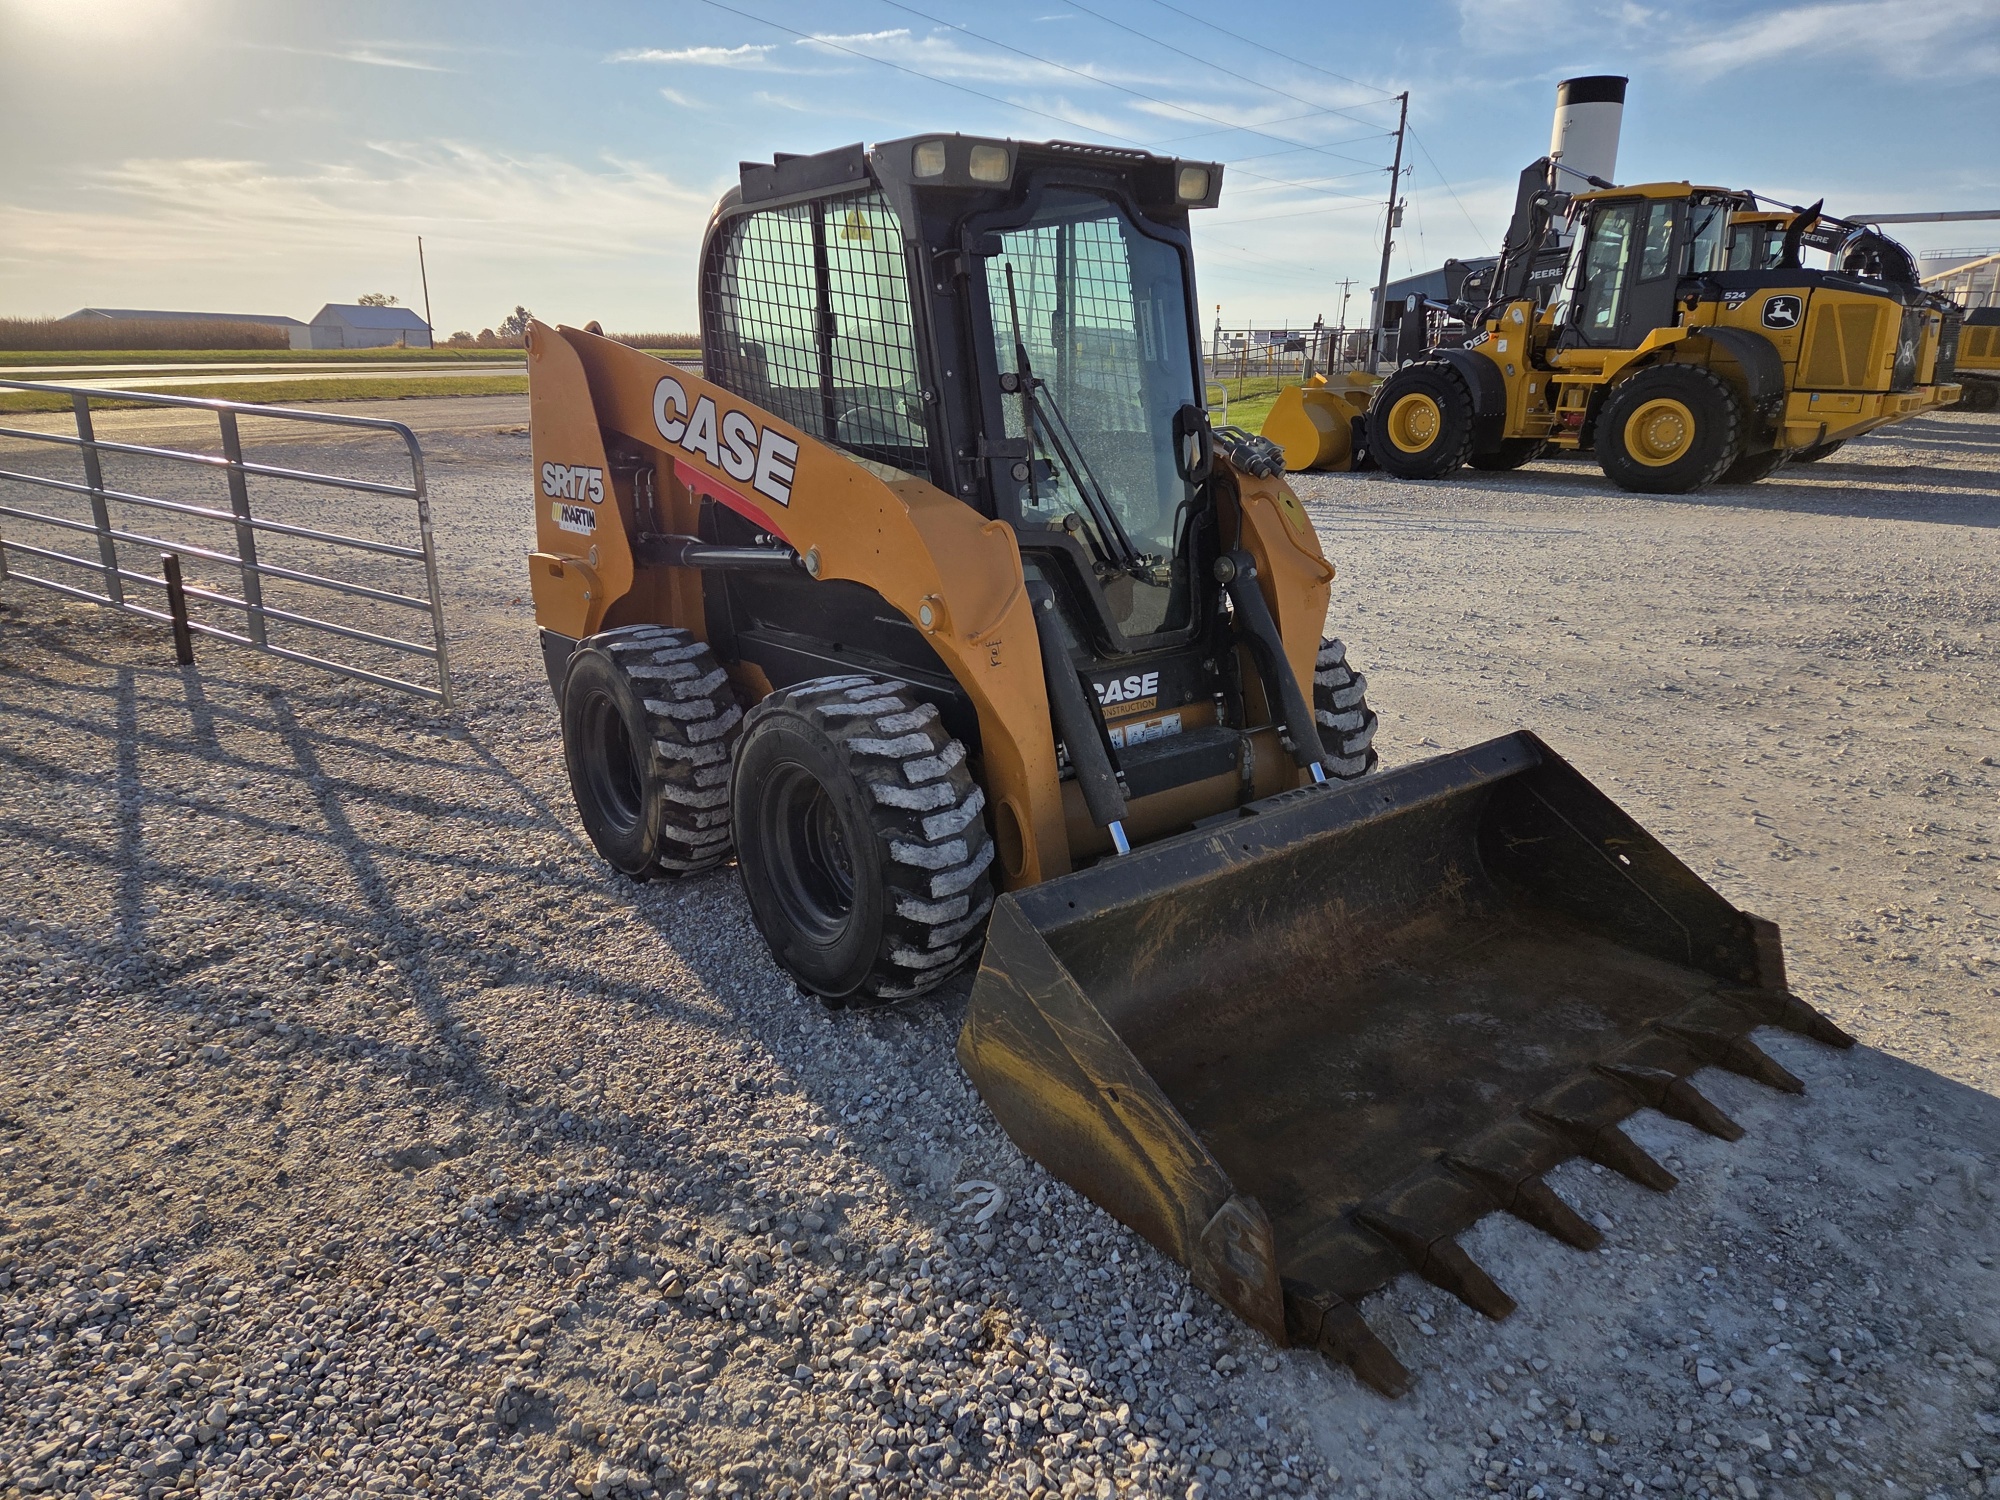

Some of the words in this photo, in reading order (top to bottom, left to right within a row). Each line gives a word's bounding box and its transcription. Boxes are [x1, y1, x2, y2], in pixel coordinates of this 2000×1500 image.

[1723, 291, 1747, 300] 524
[1727, 302, 1737, 310] P
[1463, 330, 1491, 351] DEE
[652, 376, 799, 507] CASE
[541, 462, 604, 504] SR175
[562, 505, 596, 529] MARTIN
[1093, 671, 1159, 705] CASE
[1102, 699, 1155, 718] NSTRUCTION
